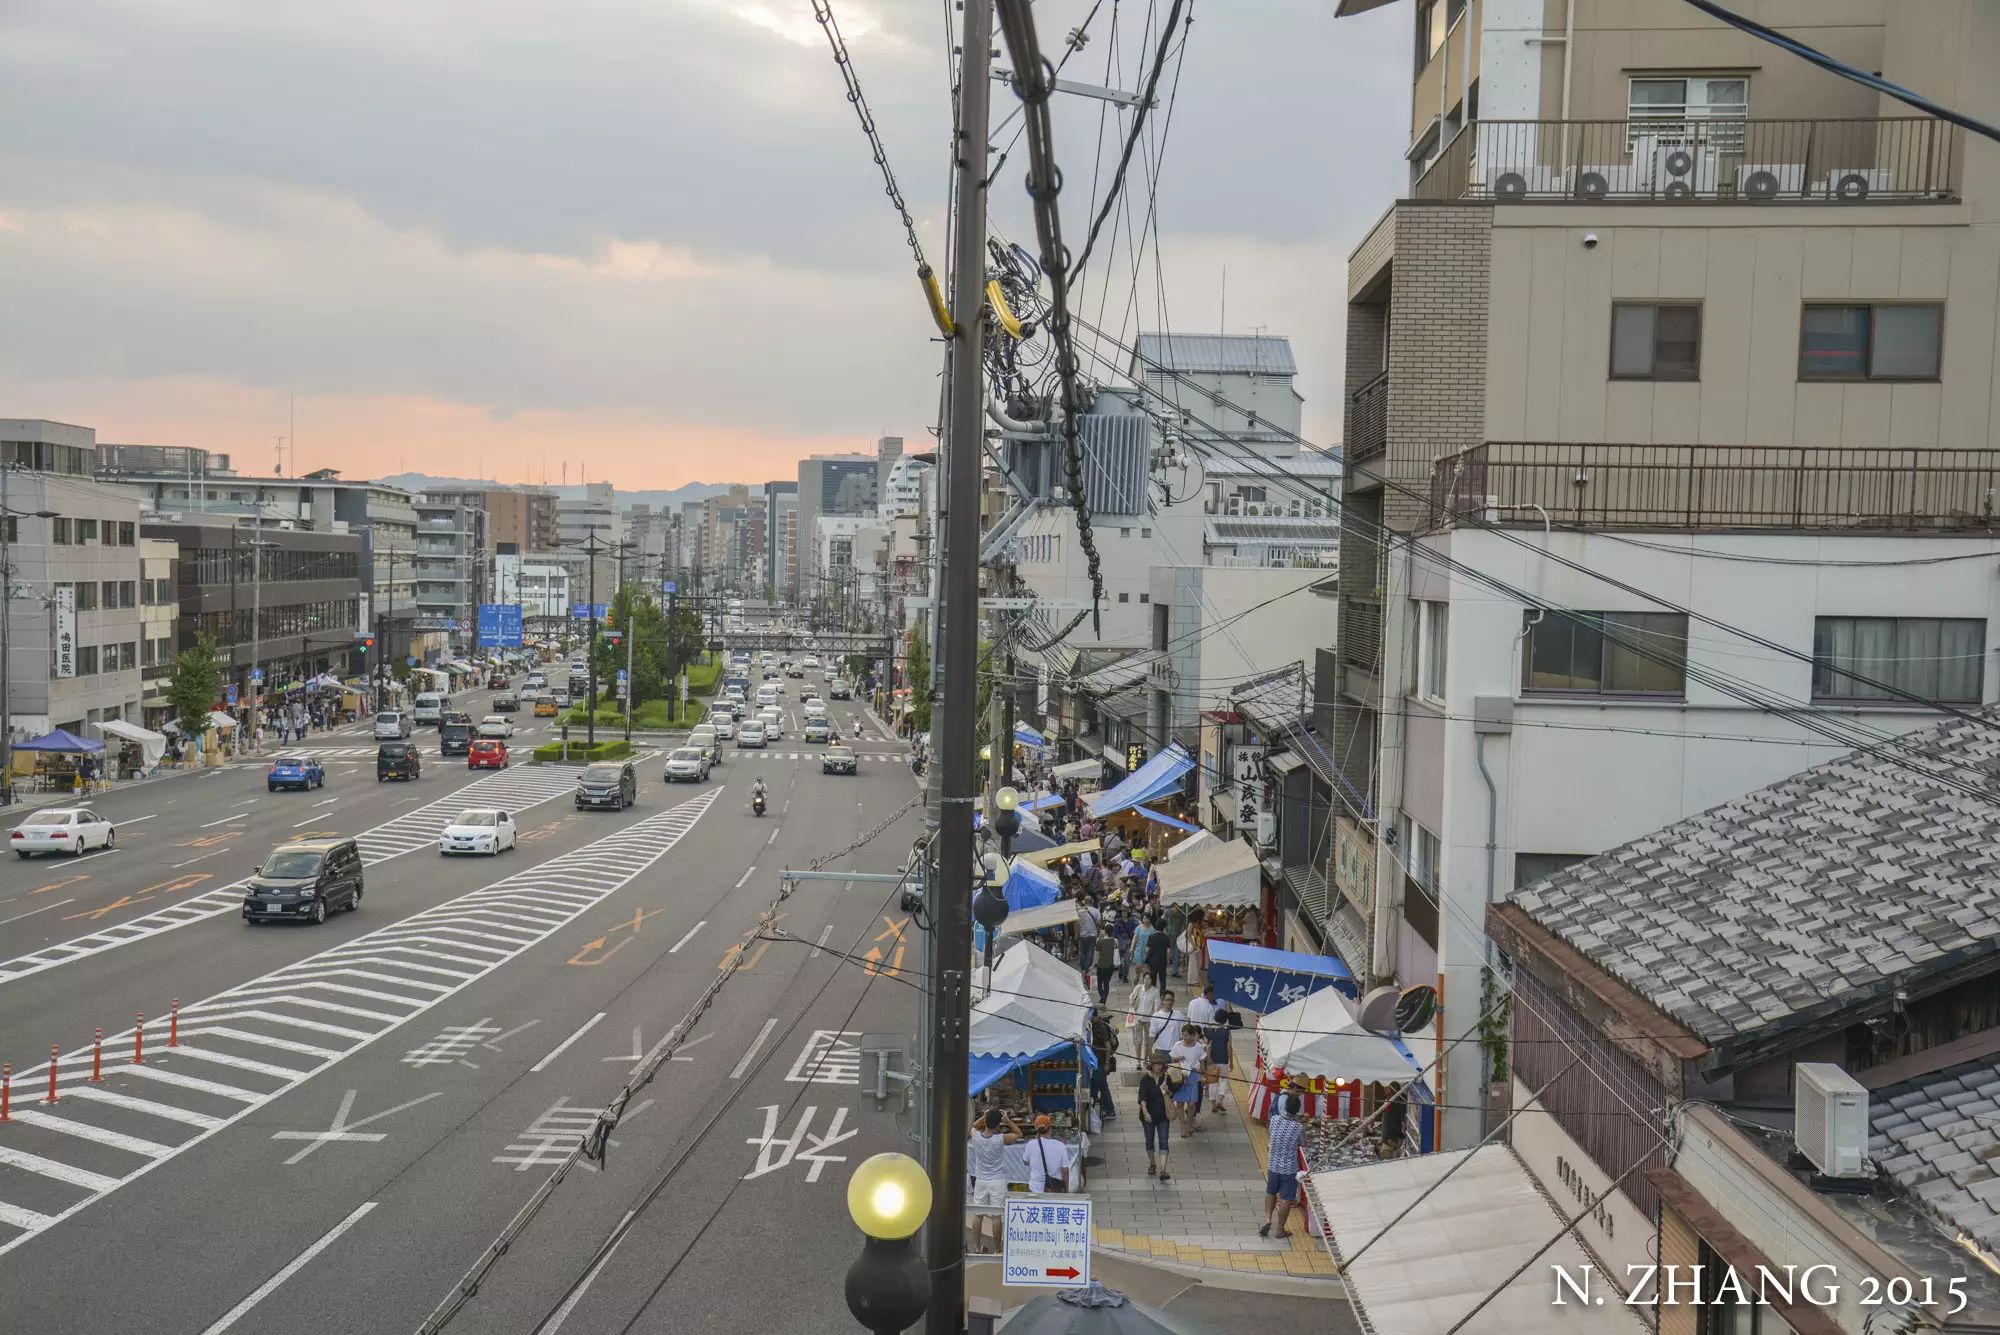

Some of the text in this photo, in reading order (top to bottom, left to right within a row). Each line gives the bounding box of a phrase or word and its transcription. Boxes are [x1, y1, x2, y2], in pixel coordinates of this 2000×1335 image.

[1279, 1078, 1337, 1094] SLE
[1010, 1206, 1086, 1226] 六波羅蜜寺
[1008, 1226, 1086, 1245] Rokuharamitsuji Temple
[1008, 1266, 1038, 1277] 300m
